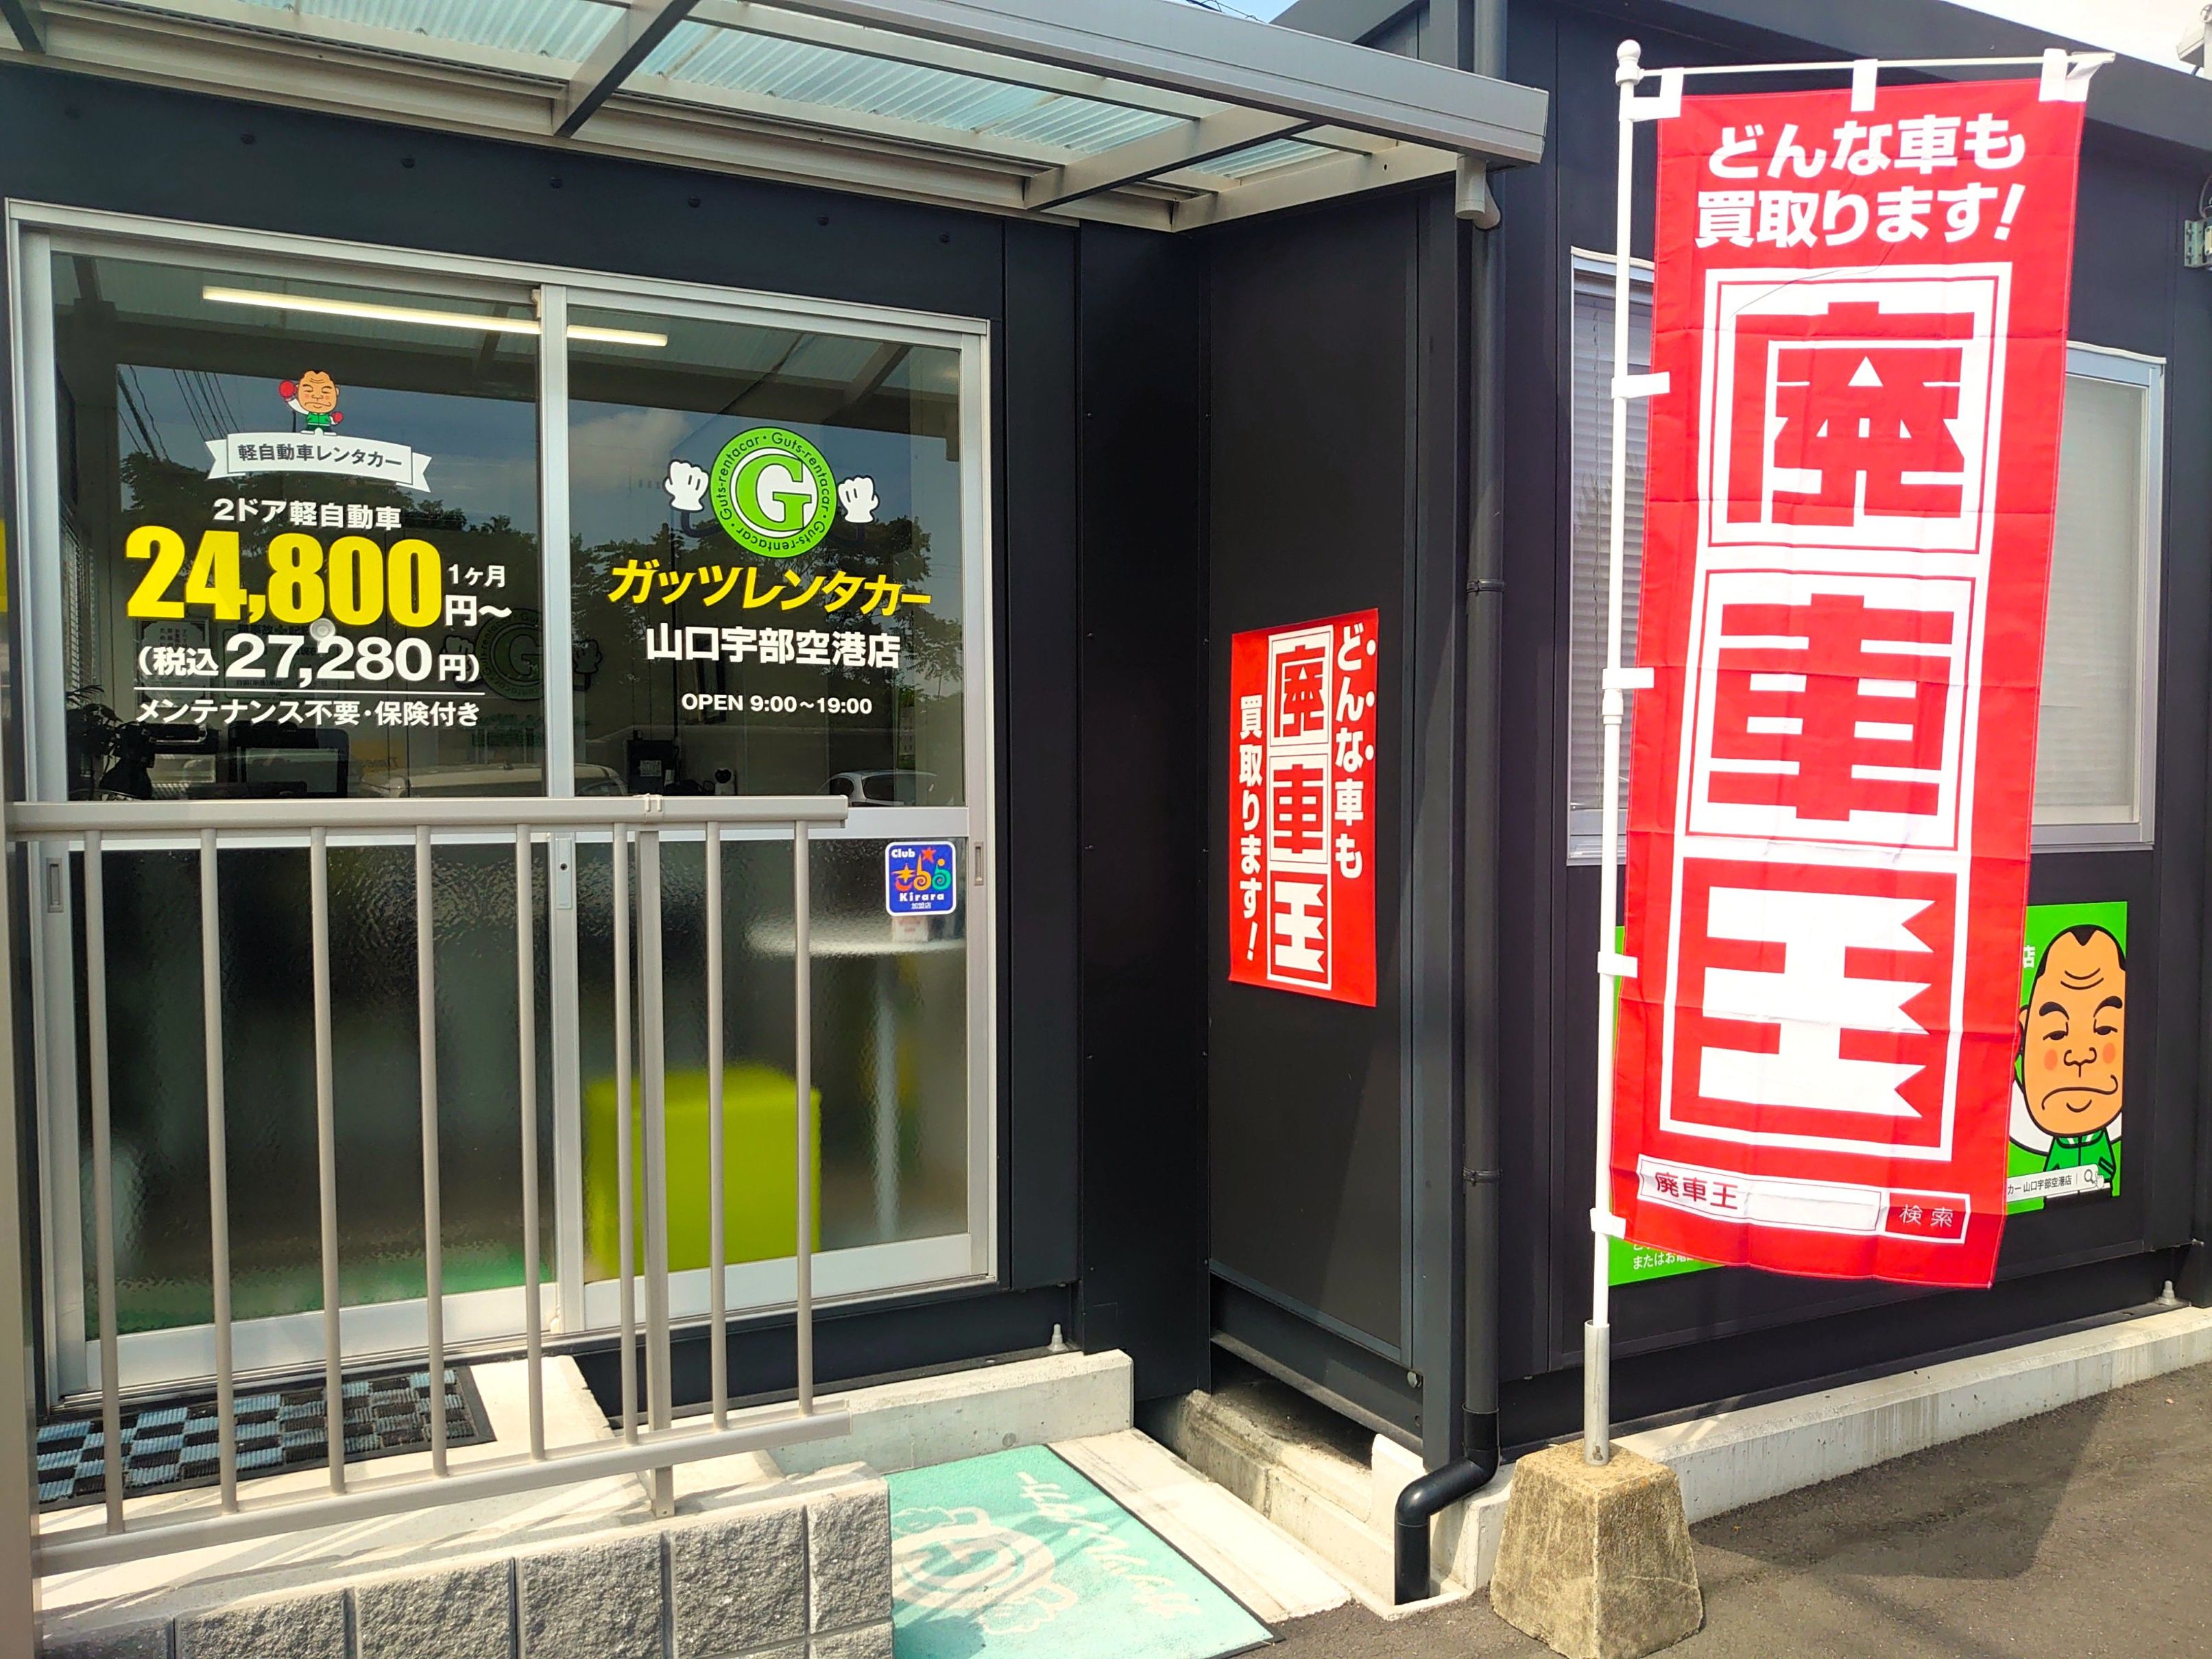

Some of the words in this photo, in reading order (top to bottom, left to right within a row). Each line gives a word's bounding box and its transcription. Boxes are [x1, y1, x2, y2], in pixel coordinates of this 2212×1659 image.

[1707, 113, 2026, 179] どんな車も
[1695, 183, 2026, 248] 買取ります!
[237, 442, 403, 468] 軽自動車レンタカー
[771, 432, 830, 512] Guts-rentacar
[717, 435, 760, 520] Guts-rentacar
[736, 453, 813, 532] G
[213, 498, 402, 531] 2ドア軽自動車
[736, 520, 826, 552] Guts-rentacar
[608, 558, 933, 616] ガッツレンタカー
[646, 622, 902, 668] 山口宇部空港店
[134, 698, 480, 727] メンテナンス不要・保険付き
[682, 694, 743, 712] OPEN
[1334, 622, 1375, 880] どんな車も
[1238, 694, 1264, 962] 買取ります!
[891, 848, 916, 858] Club
[899, 892, 945, 902] Kirara
[1654, 1171, 1740, 1210] 廃車王
[2023, 1174, 2073, 1193] 山口宇部空港店
[1899, 1202, 1954, 1228] 検索
[1016, 1470, 1203, 1619] ガッツレンタカー
